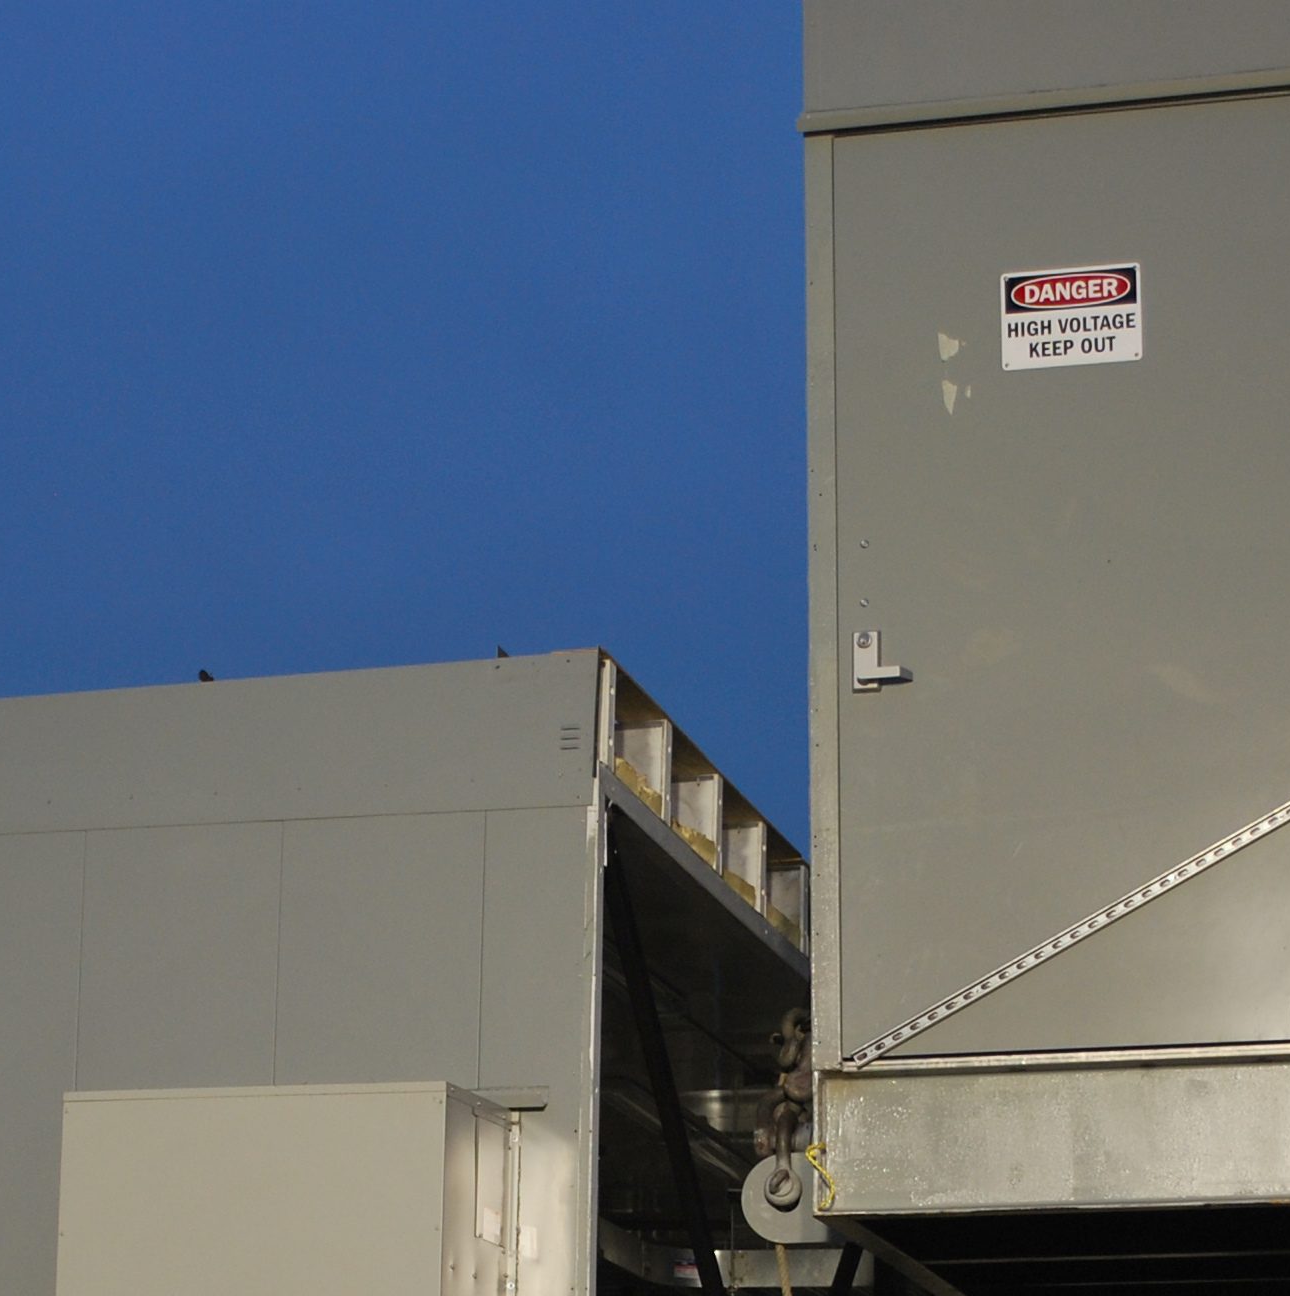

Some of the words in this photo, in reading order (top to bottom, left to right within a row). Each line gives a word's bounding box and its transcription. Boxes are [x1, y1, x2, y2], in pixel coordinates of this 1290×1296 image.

[1024, 279, 1118, 304] DANGER
[1007, 319, 1052, 338] HIGH
[1058, 313, 1136, 334] VOLTAGE
[1029, 339, 1074, 358] KEEP
[1080, 335, 1116, 354] OUT
